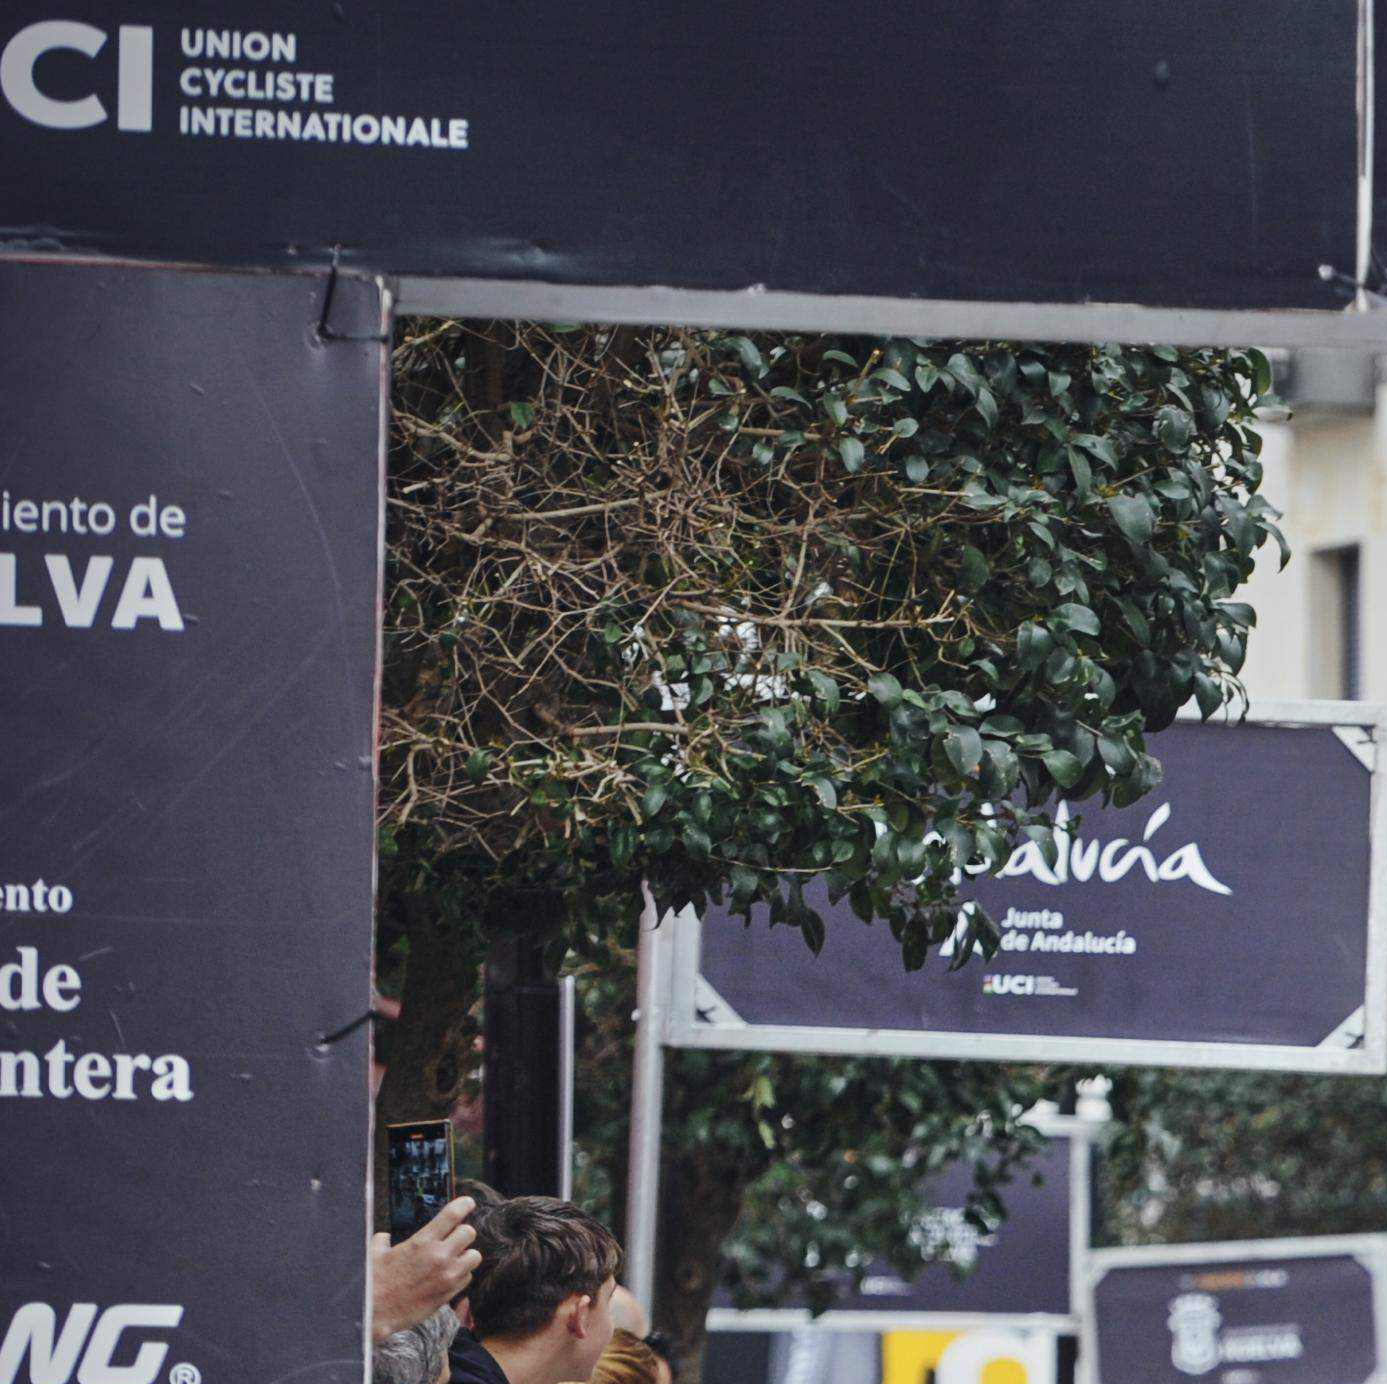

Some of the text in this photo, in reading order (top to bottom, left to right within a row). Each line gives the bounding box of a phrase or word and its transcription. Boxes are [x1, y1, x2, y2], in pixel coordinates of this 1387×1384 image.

[181, 28, 296, 62] UNION
[0, 20, 153, 132] CI
[180, 69, 334, 103] CYCLISTE
[180, 106, 469, 149] INTERNATIONALE
[129, 496, 186, 537] de
[0, 552, 185, 632] LVA
[1001, 906, 1064, 929] Junta
[1001, 930, 1137, 955] de Andalucía
[0, 947, 81, 1011] de
[992, 973, 1036, 995] UCI
